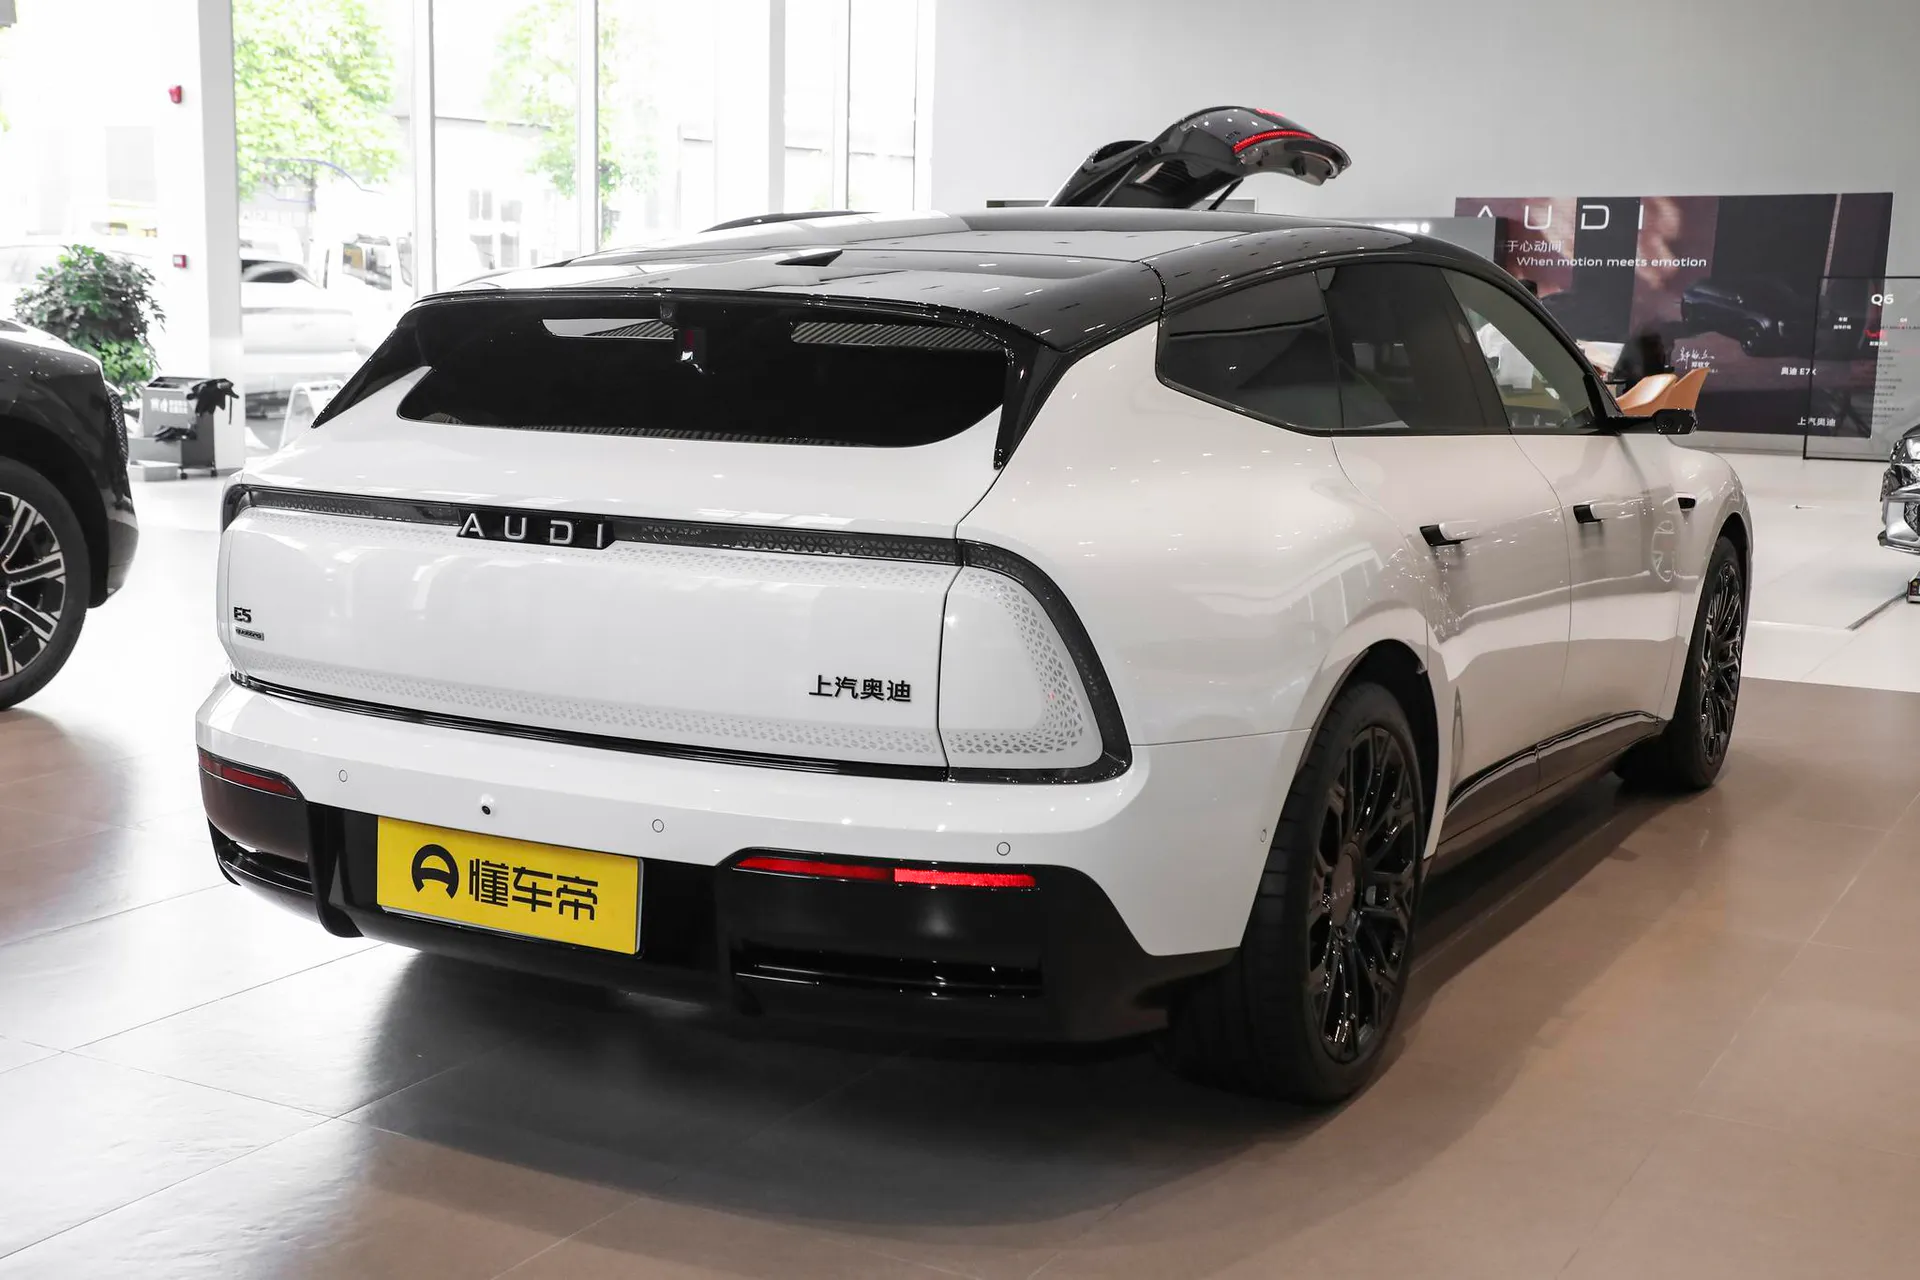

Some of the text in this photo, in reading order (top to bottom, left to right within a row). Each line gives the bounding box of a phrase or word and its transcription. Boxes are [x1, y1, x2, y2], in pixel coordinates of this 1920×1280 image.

[1516, 256, 1707, 267] When motion meets emotion
[1871, 293, 1894, 306] Q6
[1797, 416, 1836, 427] 上汽奥迪
[459, 512, 604, 548] AUDI
[233, 606, 251, 624] E5
[808, 674, 912, 703] 上汽奥迪
[468, 858, 599, 921] 懂车帝
